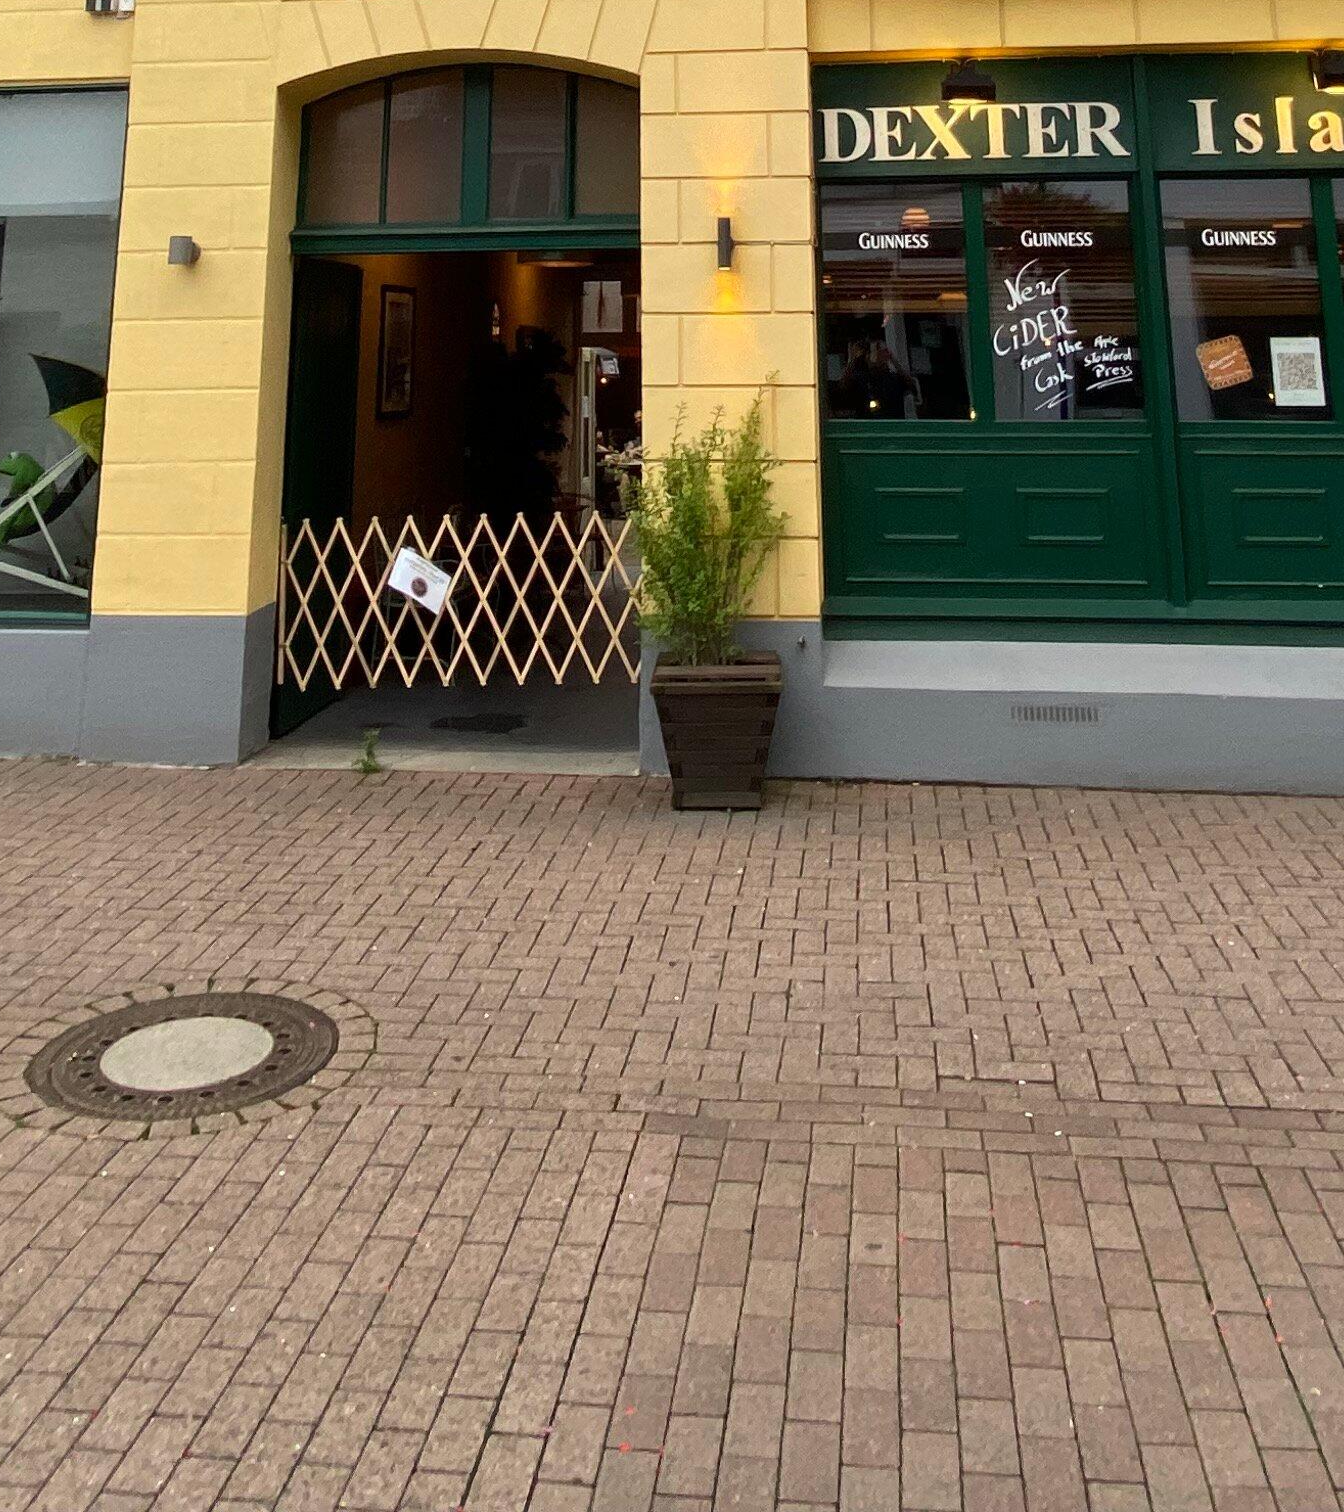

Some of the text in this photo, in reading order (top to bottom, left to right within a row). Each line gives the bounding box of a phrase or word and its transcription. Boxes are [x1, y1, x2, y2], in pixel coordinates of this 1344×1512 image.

[817, 101, 1131, 163] DEXTER
[858, 232, 929, 250] GUINNESS
[1020, 230, 1094, 248] GUINNESS
[1201, 228, 1277, 246] GUINNESS
[1004, 258, 1071, 311] New
[1056, 340, 1084, 357] the
[1092, 364, 1133, 378] Press
